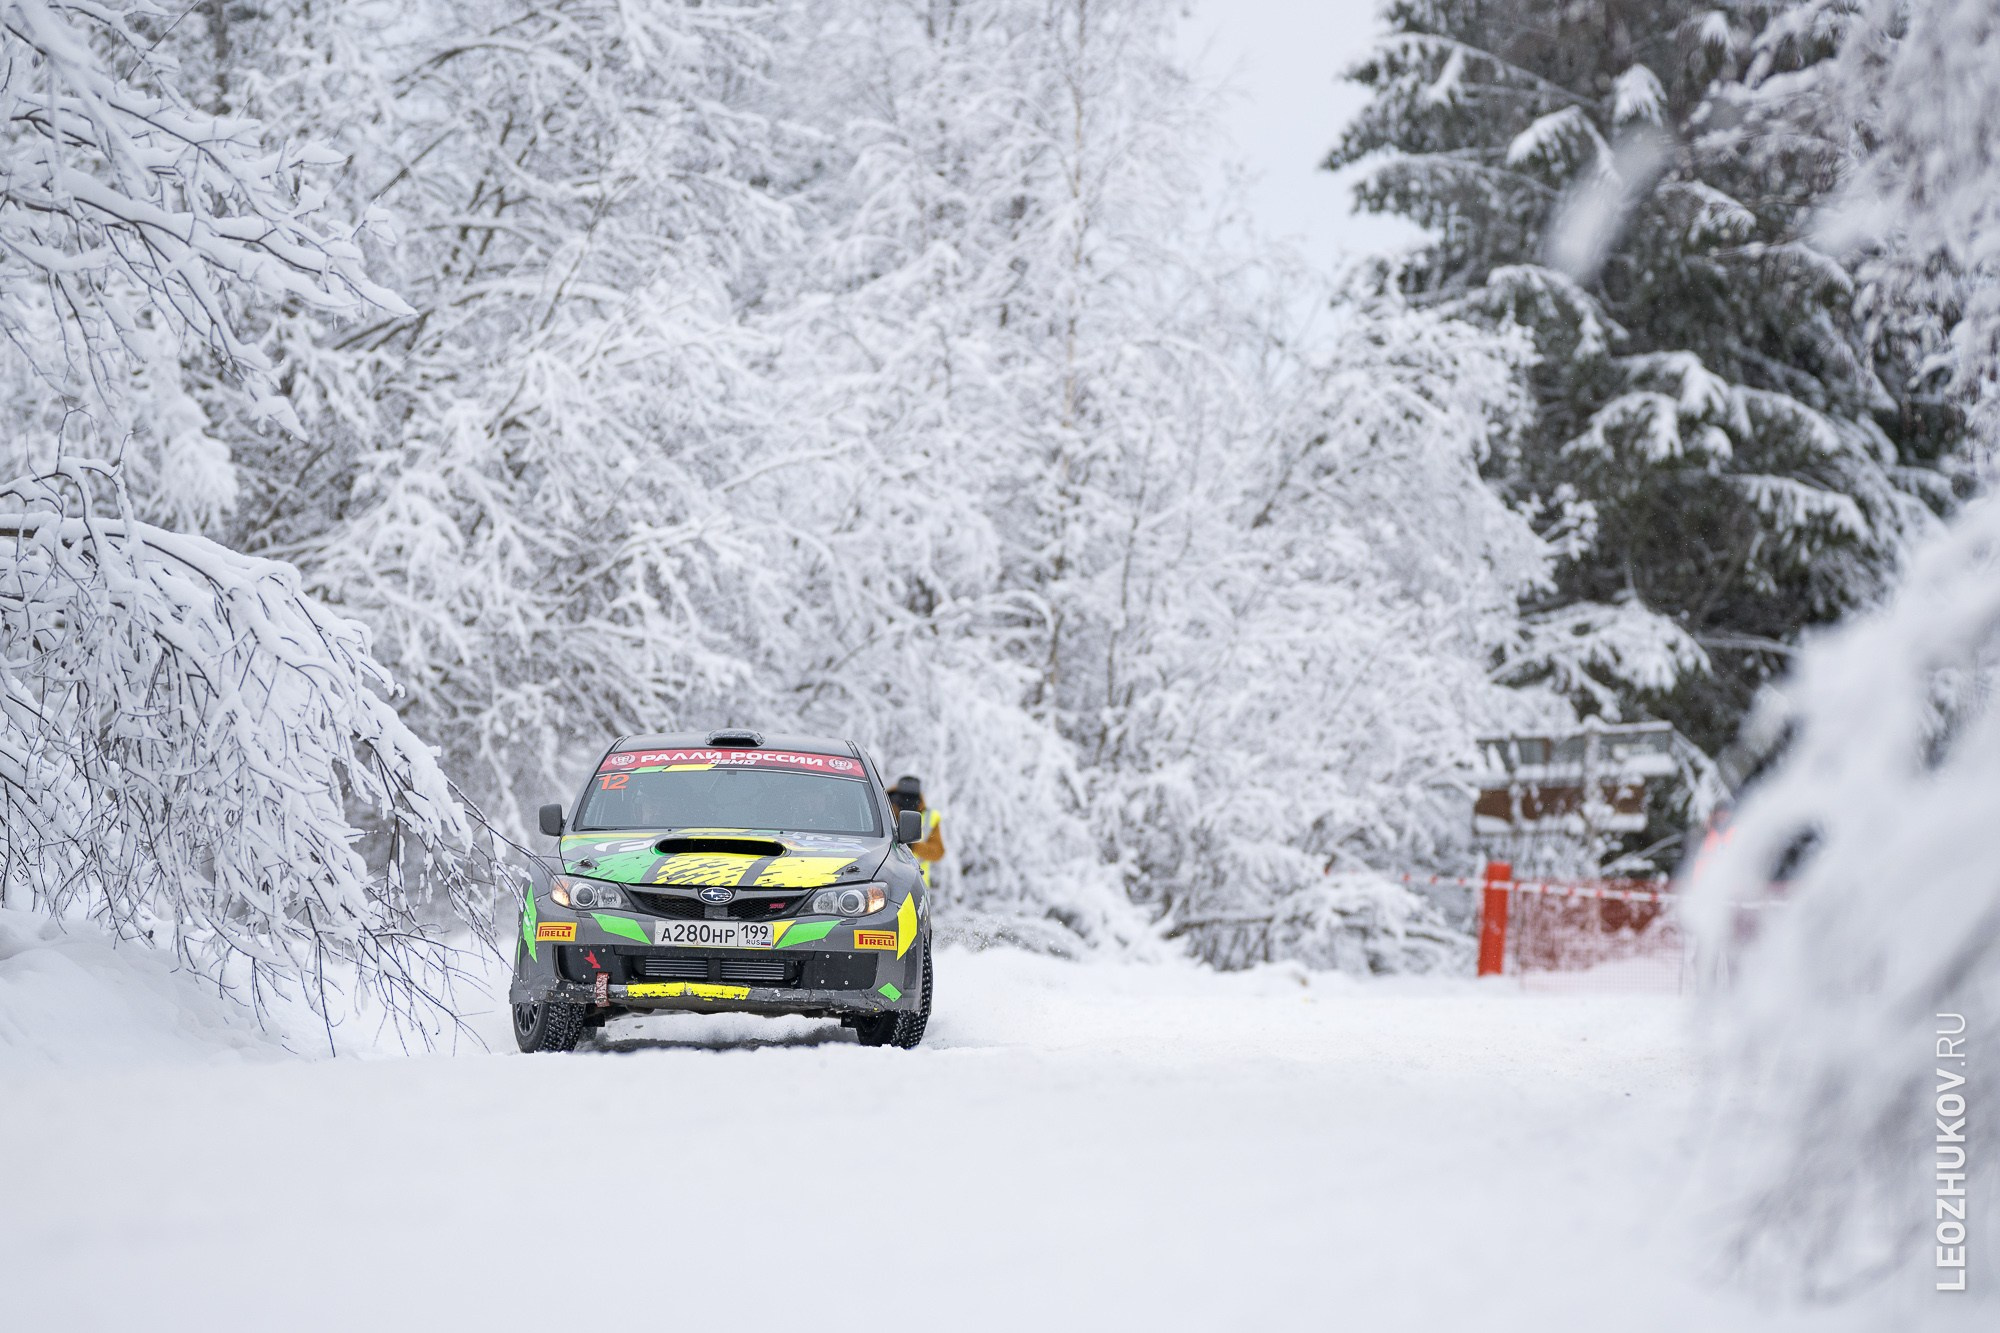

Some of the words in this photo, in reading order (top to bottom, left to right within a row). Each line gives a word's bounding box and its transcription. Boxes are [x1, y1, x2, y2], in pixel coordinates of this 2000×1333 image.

[640, 752, 722, 763] РАЛЛИ
[730, 752, 823, 766] РОССИИ
[599, 774, 629, 790] 12
[538, 925, 572, 938] PIRELLI
[741, 925, 769, 940] 199
[858, 933, 895, 947] PIRELLI
